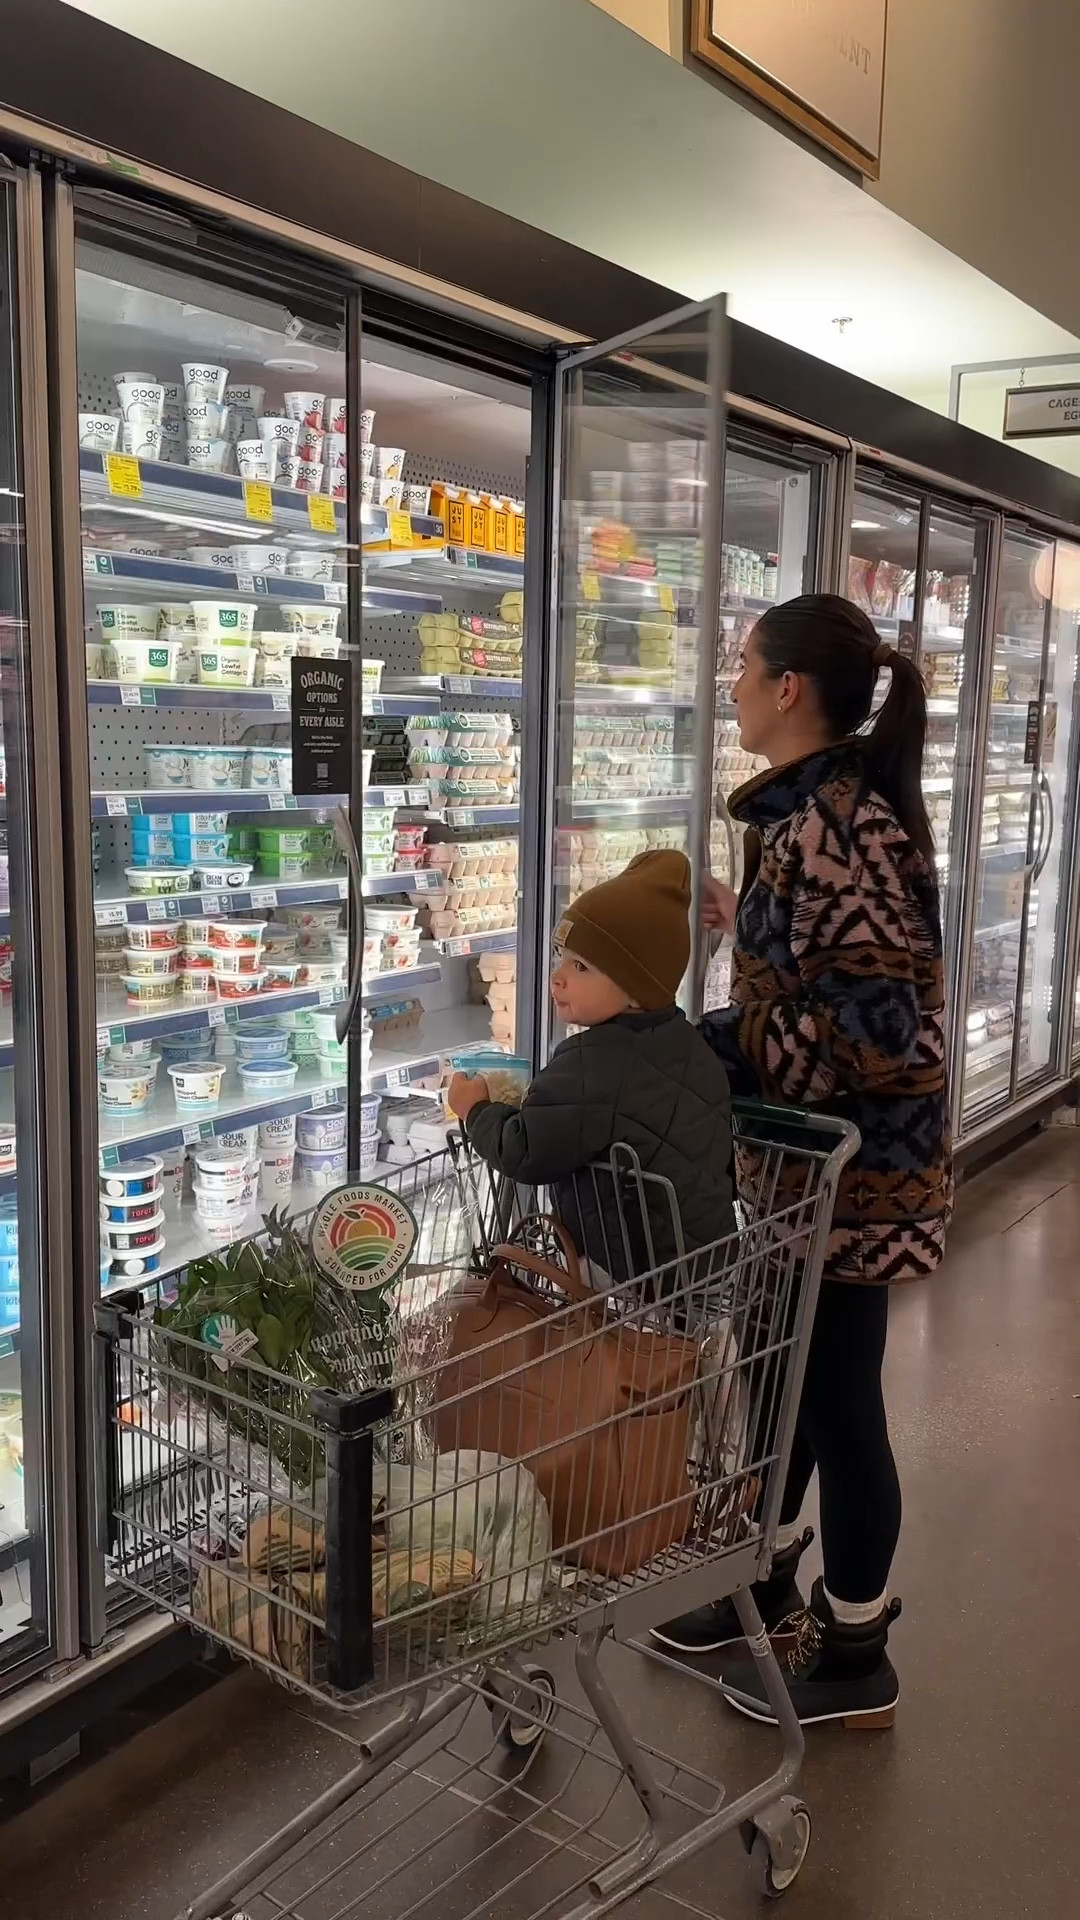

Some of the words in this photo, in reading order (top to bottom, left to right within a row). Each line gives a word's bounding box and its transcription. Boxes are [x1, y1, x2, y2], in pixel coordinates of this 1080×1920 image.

[189, 368, 219, 380] good
[1063, 411, 1080, 420] EG
[451, 507, 462, 515] JU
[451, 516, 462, 524] ST
[434, 525, 443, 534] 30
[220, 613, 237, 622] 365
[150, 652, 167, 661] 365
[203, 656, 217, 665] 365
[300, 671, 344, 691] ORGANIC
[306, 692, 338, 704] OPTIONS
[300, 715, 323, 727] EVERY
[324, 715, 345, 727] AISLE
[219, 1140, 247, 1148] CREAM
[337, 1191, 371, 1206] FOODS
[373, 1194, 408, 1225] MARKET
[325, 1256, 365, 1286] SOURCED
[368, 1268, 387, 1284] FOR
[387, 1243, 406, 1270] GOOD
